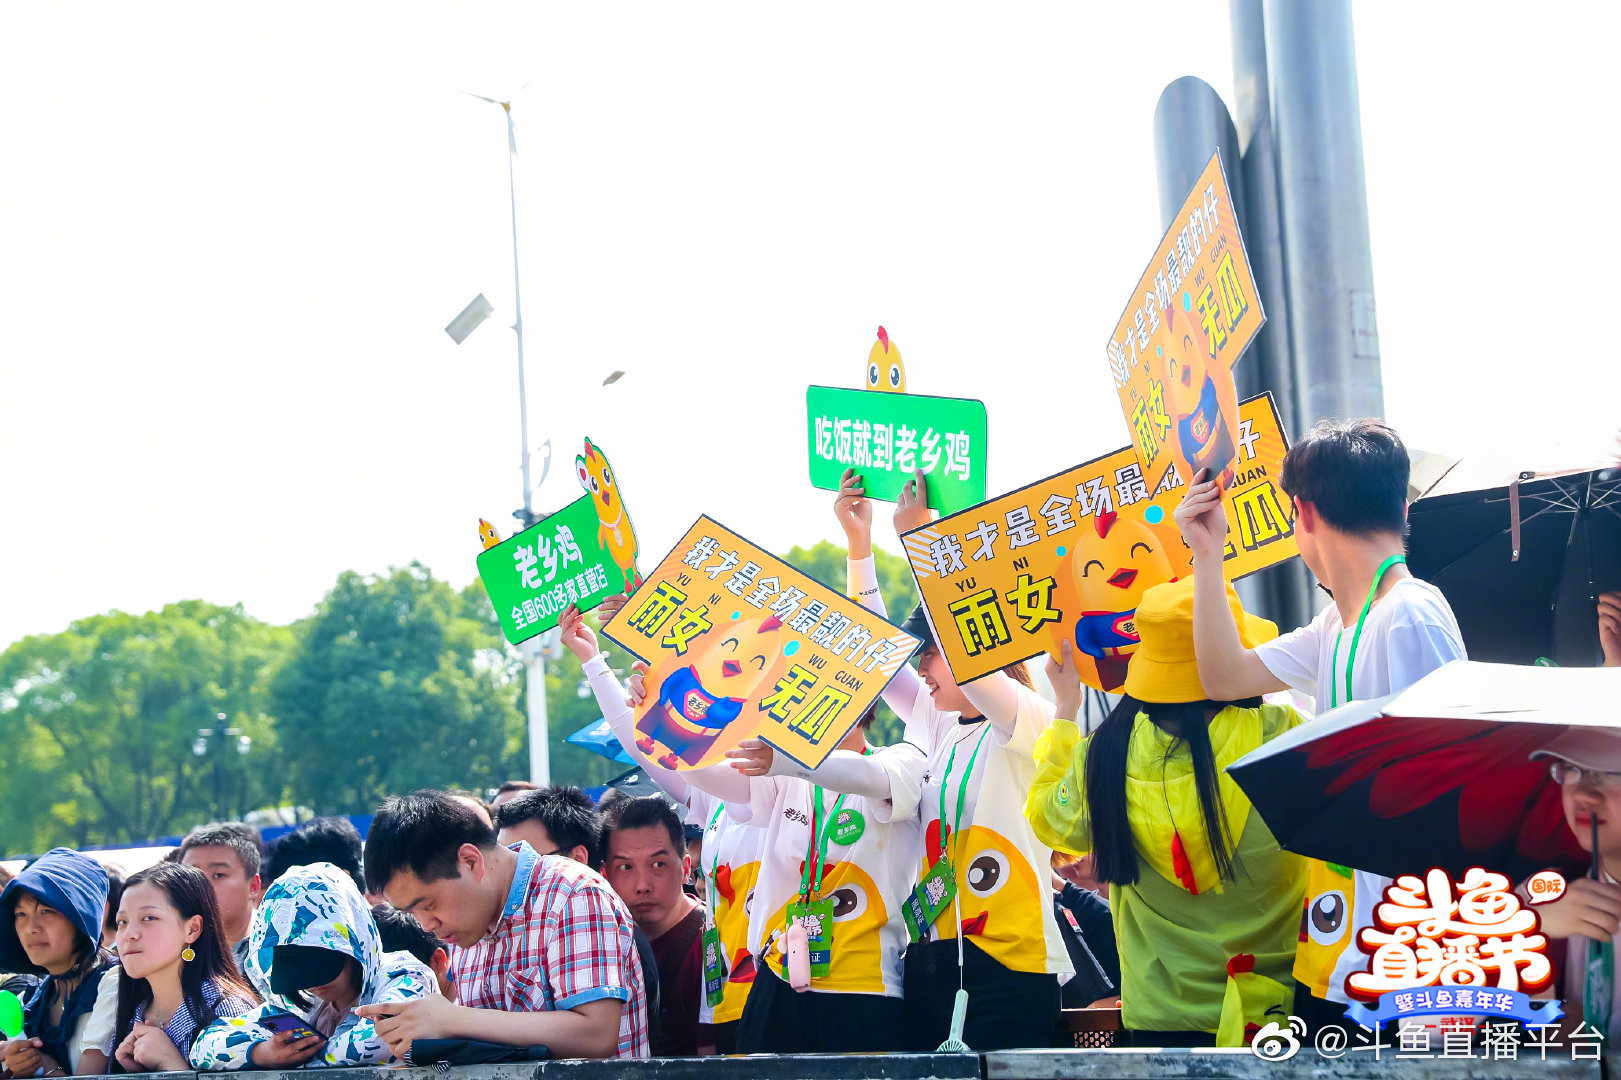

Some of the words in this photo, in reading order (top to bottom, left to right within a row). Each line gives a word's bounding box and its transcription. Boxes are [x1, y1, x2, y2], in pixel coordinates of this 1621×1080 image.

[1116, 181, 1219, 388] 我才是全场最靓的仔
[1194, 266, 1206, 288] WU
[1210, 233, 1227, 263] GUAN
[1131, 378, 1172, 468] 雨女
[1196, 249, 1249, 360] 无瓜
[814, 414, 971, 481] 吃饭就到老乡鸡
[929, 418, 1260, 578] 我才是全场最仔
[511, 562, 609, 631] 全国600多家直营店
[512, 524, 584, 590] 老乡鸡
[681, 535, 898, 674] 我才是全场最靓的仔
[955, 576, 977, 593] YU
[1012, 556, 1029, 571] NI
[627, 580, 713, 657] 雨女
[758, 663, 852, 746] 无瓜
[676, 572, 691, 586] YU
[708, 593, 721, 605] NI
[808, 653, 828, 670] WU
[834, 670, 864, 692] GUAN
[948, 572, 1063, 657] 雨女
